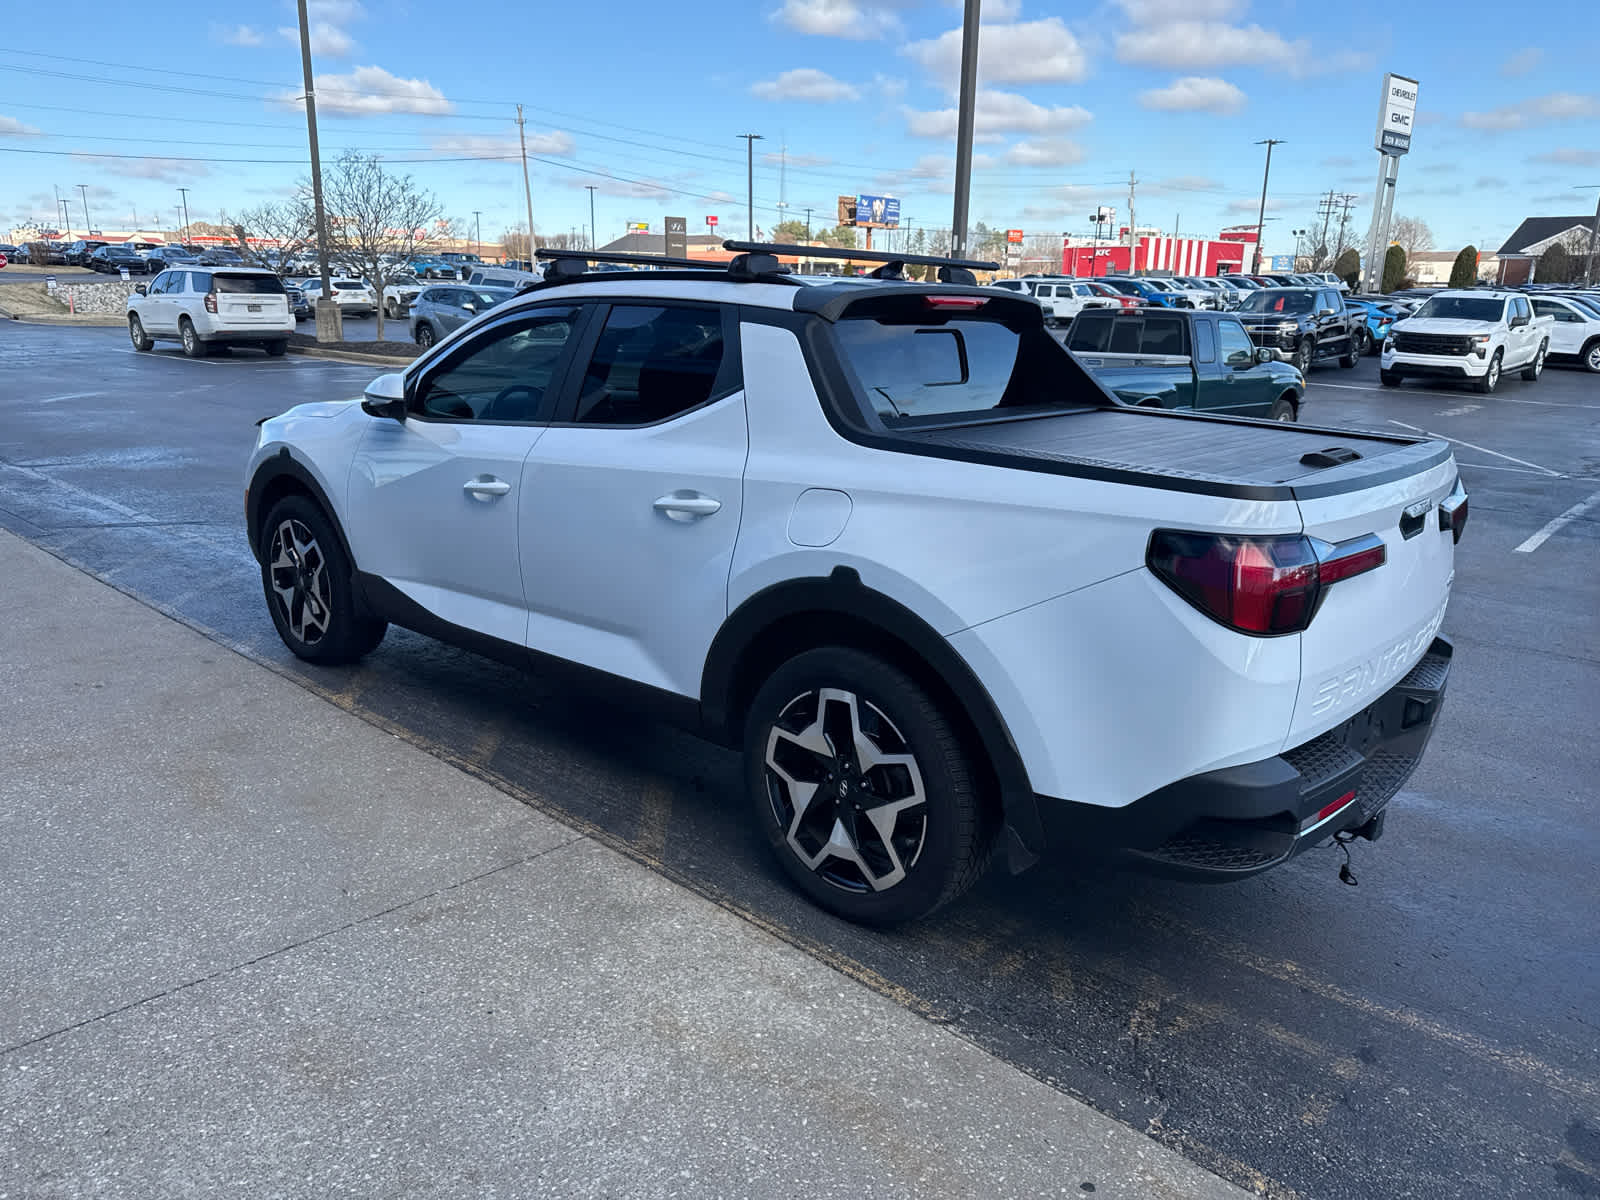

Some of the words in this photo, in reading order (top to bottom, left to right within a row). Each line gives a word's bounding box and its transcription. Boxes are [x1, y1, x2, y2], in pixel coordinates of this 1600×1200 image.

[1392, 88, 1416, 101] CHEVROLET
[1392, 113, 1410, 126] GMC
[1095, 249, 1111, 257] KFC
[1312, 641, 1410, 716] SANTA
